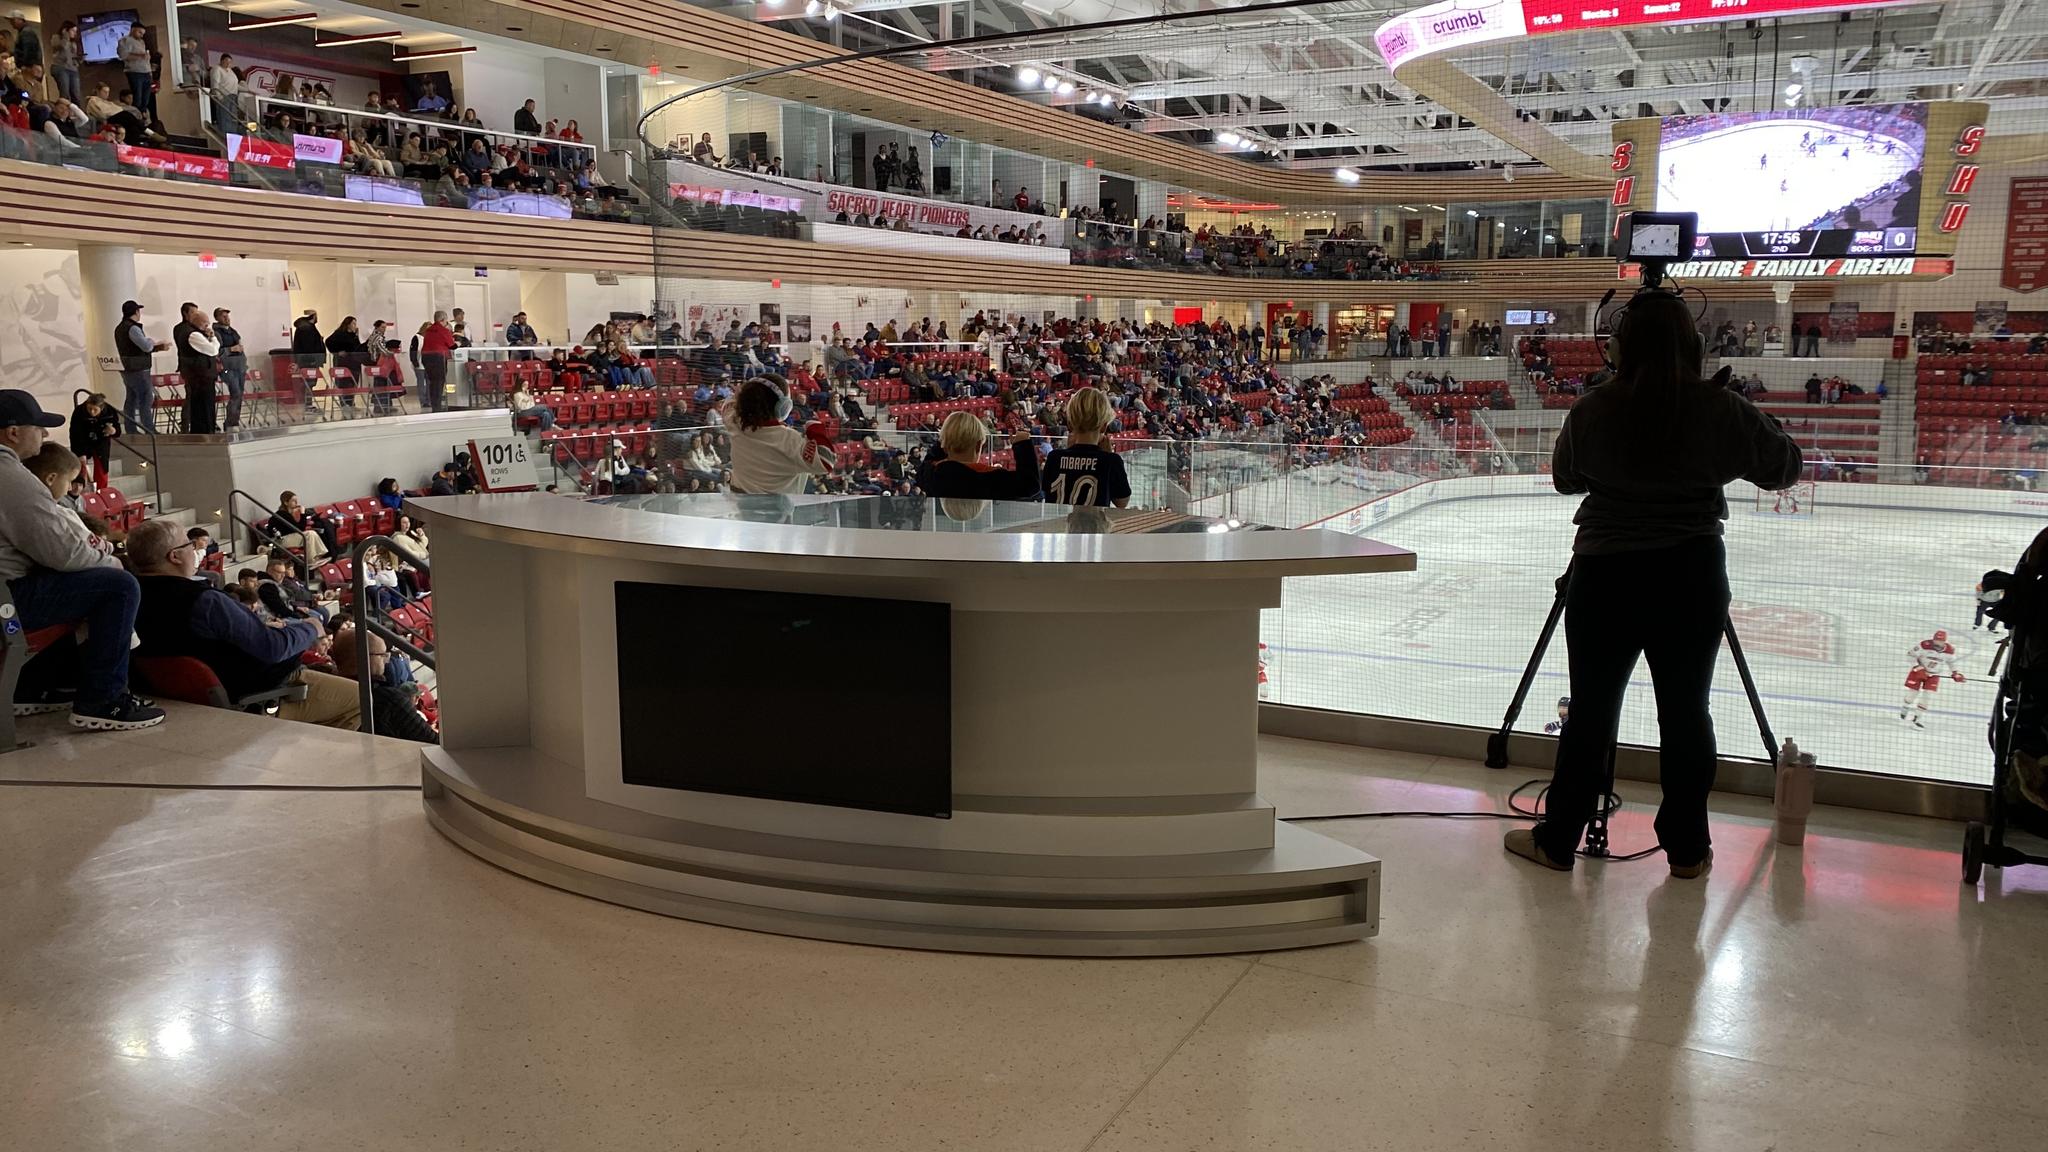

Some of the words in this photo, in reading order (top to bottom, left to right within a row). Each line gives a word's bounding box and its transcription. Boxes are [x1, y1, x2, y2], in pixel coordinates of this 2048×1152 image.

[1433, 10, 1487, 34] crumbl
[1385, 31, 1408, 54] crumbl
[1938, 125, 1986, 233] SHU
[828, 190, 878, 217] SACRED
[879, 197, 918, 221] HEART
[919, 202, 971, 228] PIONEERS
[1761, 231, 1801, 245] 17:56
[1894, 231, 1907, 247] 0
[1771, 245, 1789, 253] 2ND
[1851, 245, 1873, 253] SOG:
[1664, 260, 1748, 278] ARTIRE
[1752, 259, 1835, 278] FAMILY
[1837, 257, 1915, 275] ARENA
[483, 444, 512, 465] 101
[1060, 456, 1098, 471] MBAPPE
[491, 467, 509, 475] ROWS
[1051, 473, 1099, 507] 10
